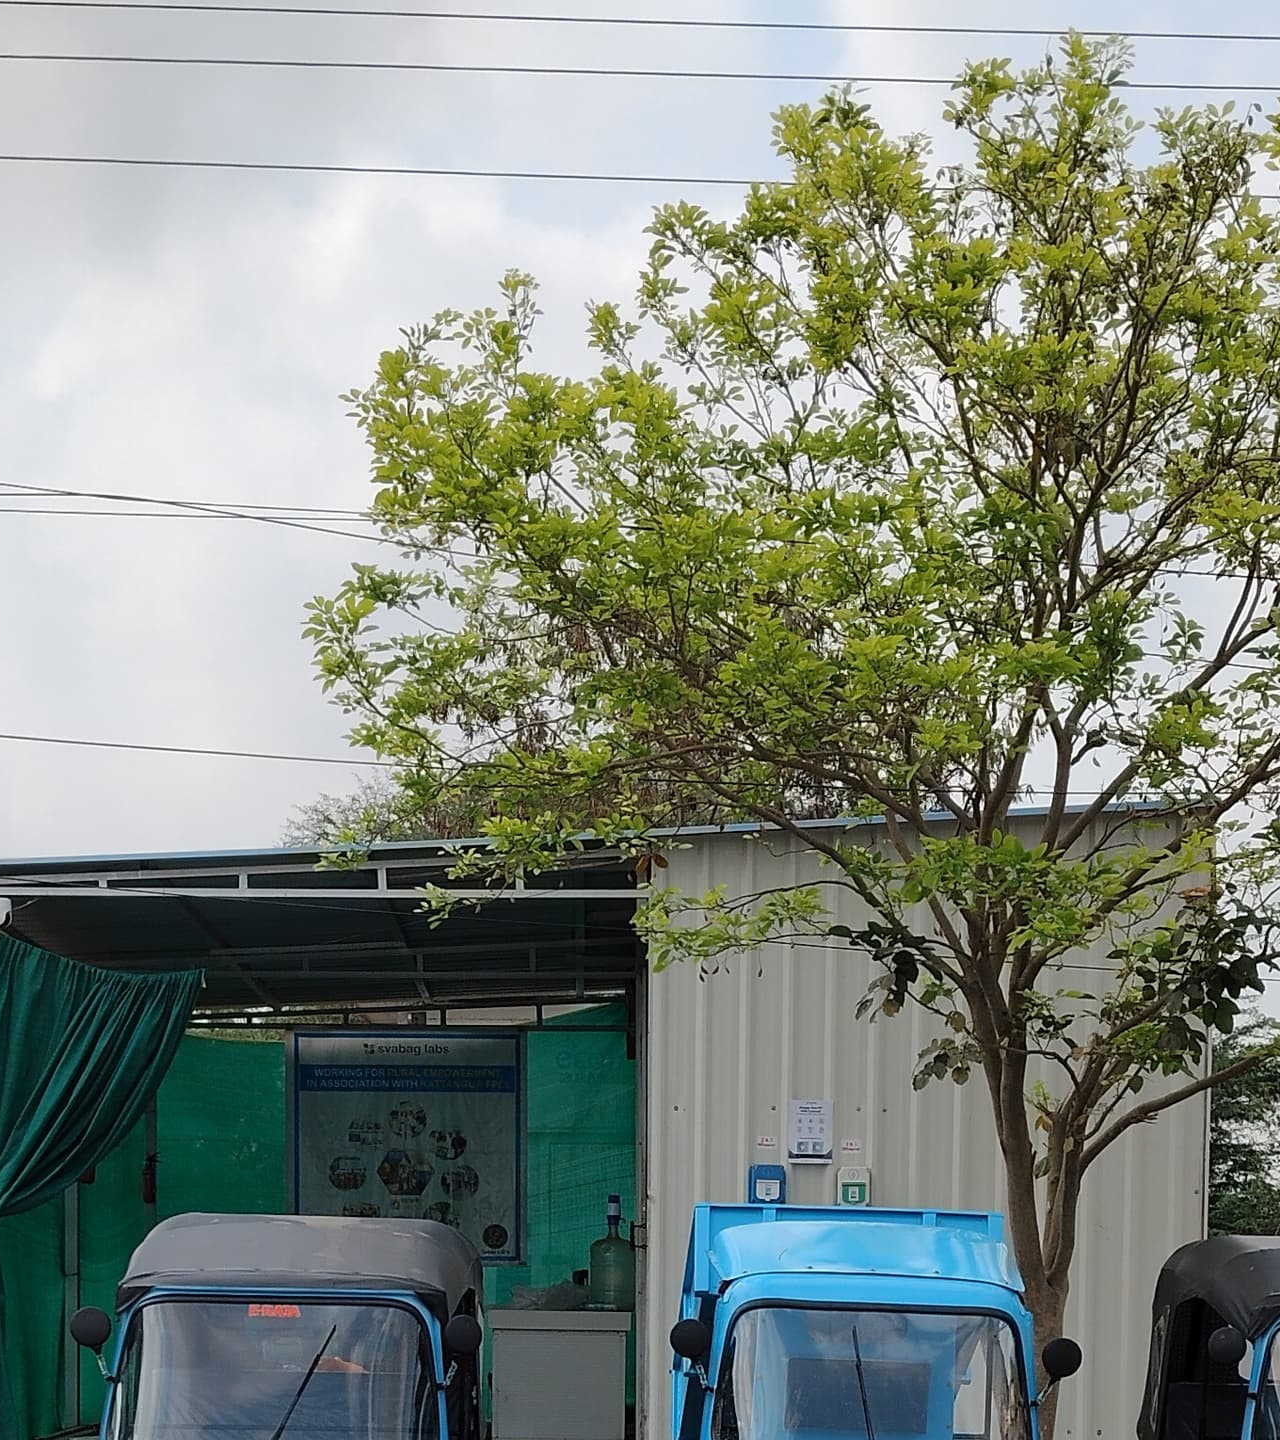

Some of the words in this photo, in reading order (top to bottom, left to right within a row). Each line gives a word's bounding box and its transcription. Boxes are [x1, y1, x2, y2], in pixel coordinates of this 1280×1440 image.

[378, 1045, 421, 1056] svabag
[424, 1044, 449, 1054] labs
[314, 1068, 363, 1077] WORKING
[365, 1068, 385, 1077] FOR
[306, 1079, 317, 1088] IN
[319, 1079, 389, 1088] ASSOCIATION
[392, 1079, 418, 1089] WITH
